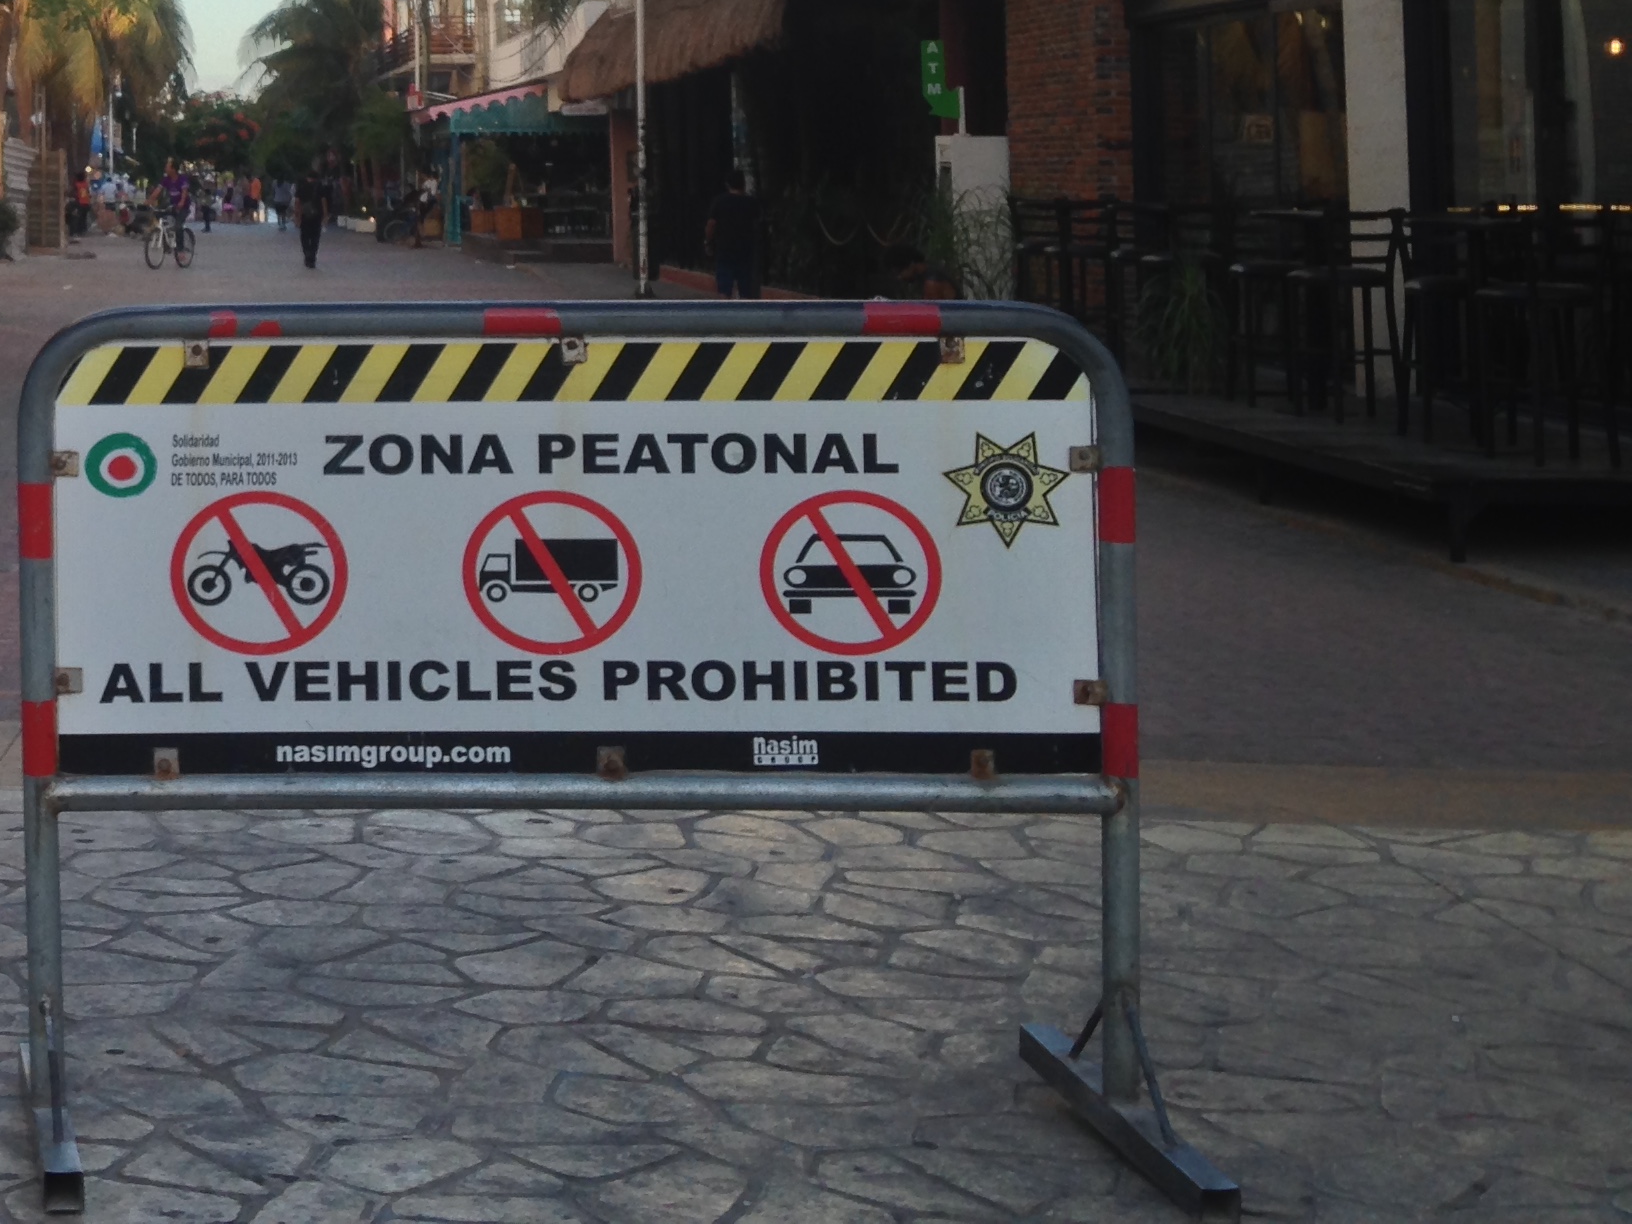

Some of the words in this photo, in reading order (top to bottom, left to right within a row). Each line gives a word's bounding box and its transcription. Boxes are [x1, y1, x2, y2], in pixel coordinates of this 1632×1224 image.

[926, 41, 941, 95] ATM
[172, 434, 219, 448] Solidaridad
[171, 453, 211, 467] Gobierno
[212, 452, 254, 469] Municipal,
[256, 452, 298, 467] 2011-2013
[323, 434, 514, 476] ZONA
[537, 432, 900, 475] PEATONAL
[171, 472, 184, 487] DE
[185, 472, 218, 488] TODOS,
[220, 471, 244, 486] PARA
[246, 471, 277, 486] TODOS
[99, 662, 223, 704] ALL
[245, 660, 577, 702] VEHICLES
[602, 659, 1018, 702] PROHIBITED
[276, 744, 511, 768] nasimgroup.com
